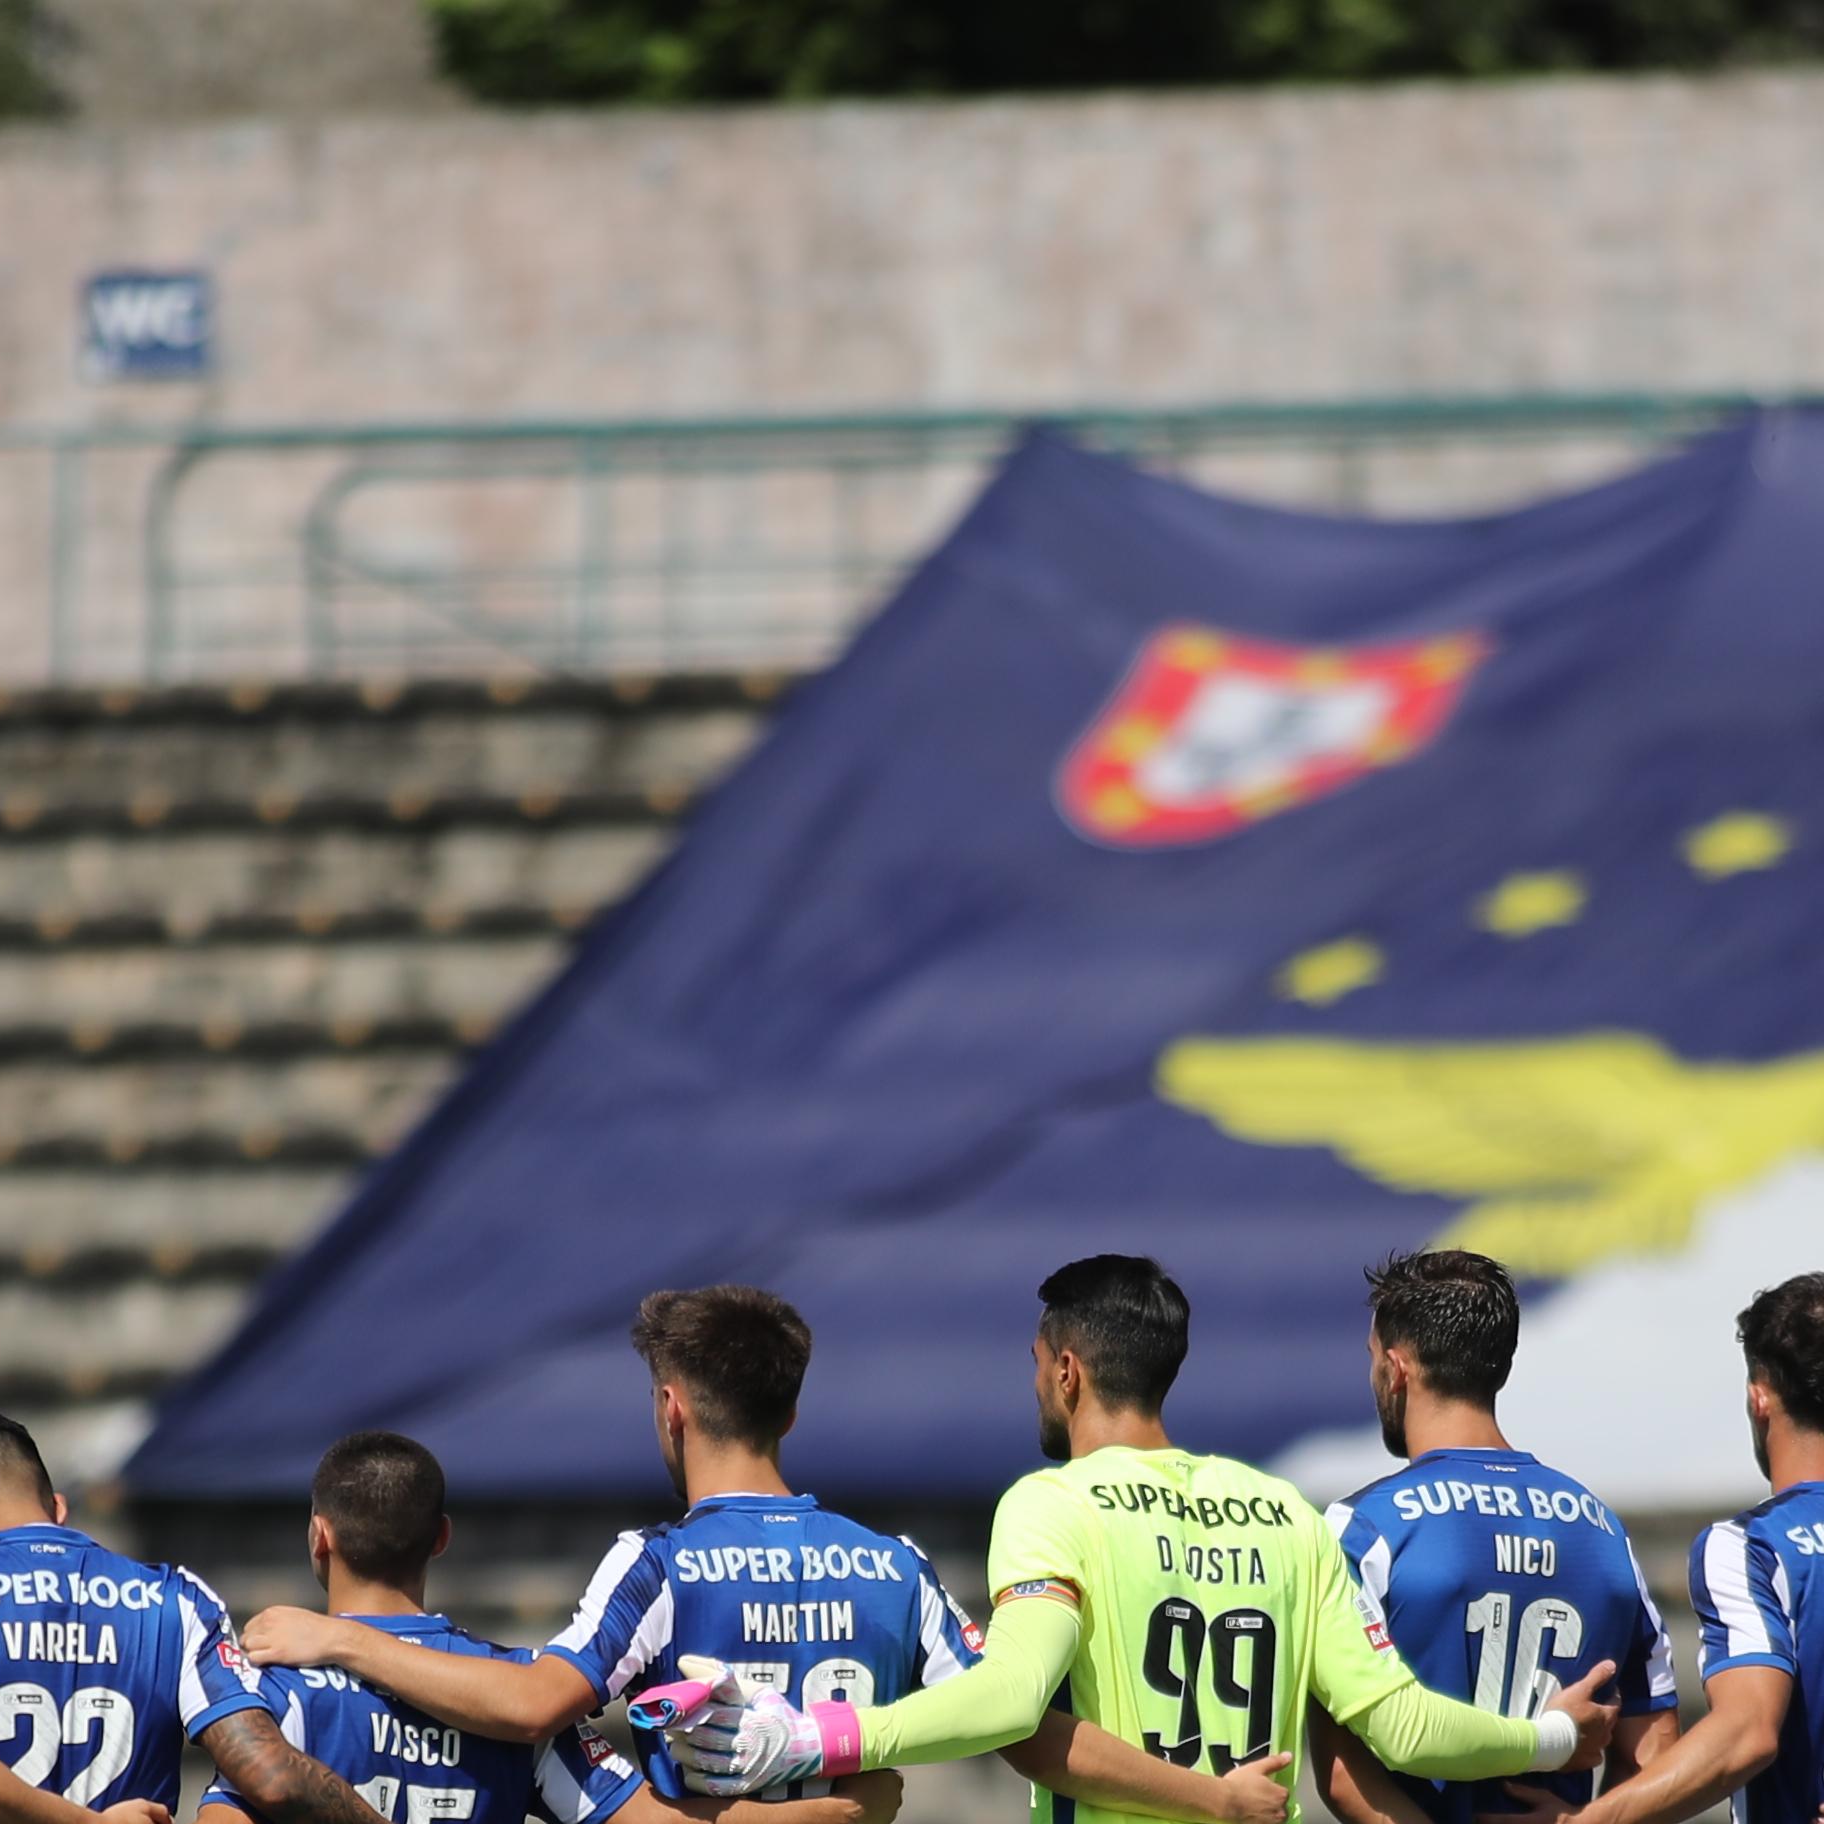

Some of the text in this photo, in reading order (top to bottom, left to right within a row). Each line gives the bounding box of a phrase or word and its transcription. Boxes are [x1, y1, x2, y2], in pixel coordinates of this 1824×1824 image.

[1196, 1497, 1294, 1530] BOCK
[1393, 1481, 1615, 1536] SUPER BOCK
[675, 1544, 902, 1583] SUPER BOCK
[1495, 1534, 1556, 1577] NICO
[69, 1573, 163, 1610] BOCK
[1, 1622, 117, 1664] VARELA
[741, 1600, 854, 1643] MARTIM
[1466, 1592, 1583, 1719] 16
[1142, 1597, 1276, 1777] 99
